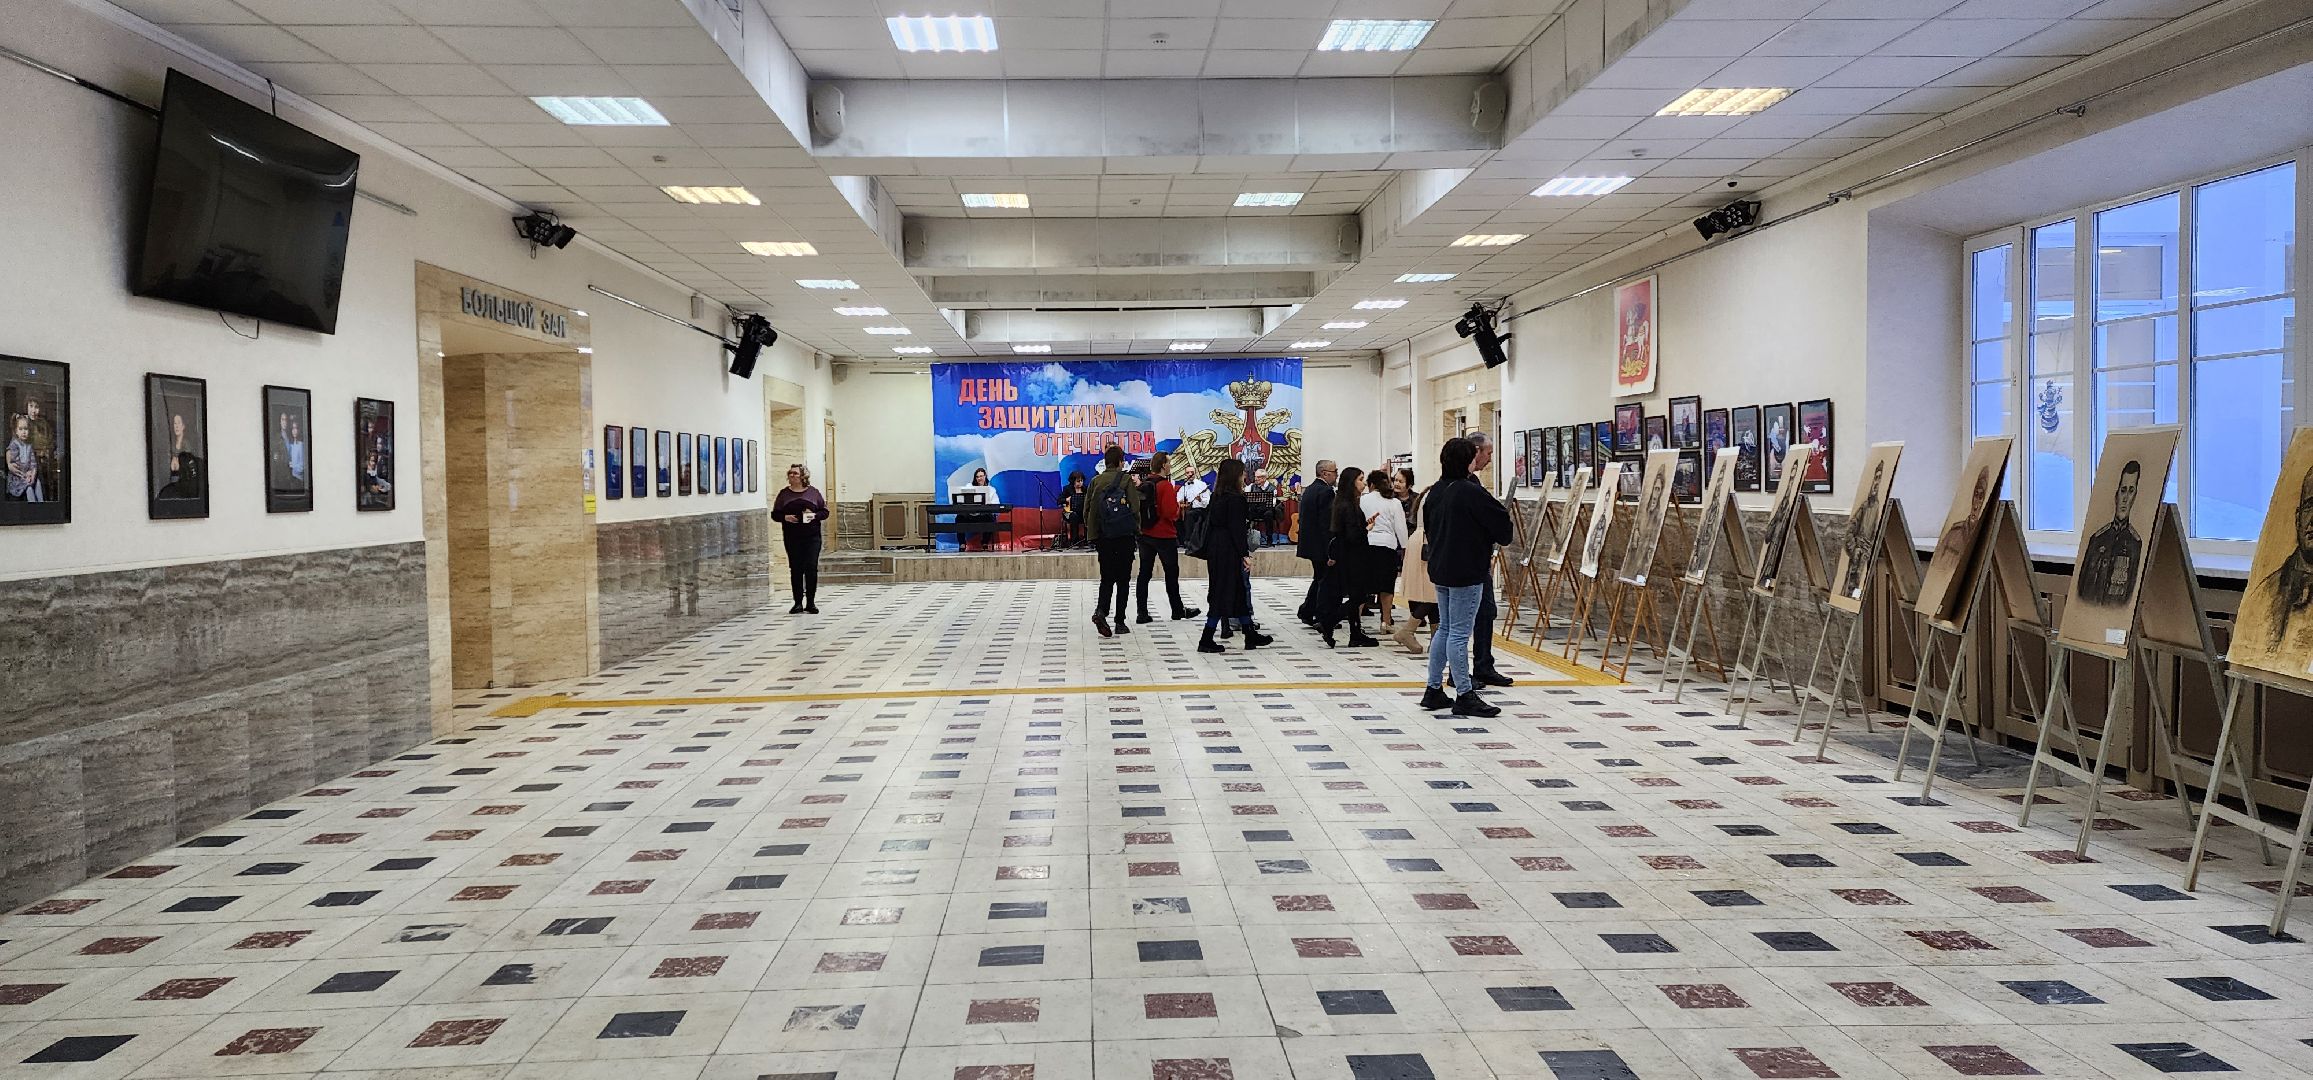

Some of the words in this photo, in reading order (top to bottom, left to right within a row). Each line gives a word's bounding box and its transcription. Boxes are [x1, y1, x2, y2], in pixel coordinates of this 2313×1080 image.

[461, 287, 535, 330] БОЛЬШОЙ
[541, 309, 567, 338] ЗАЛ
[959, 378, 1018, 405] ДЕНЬ
[978, 404, 1118, 432] ЗАЩИТНИКА
[1033, 431, 1157, 456] ОТЕЧЕСТВА
